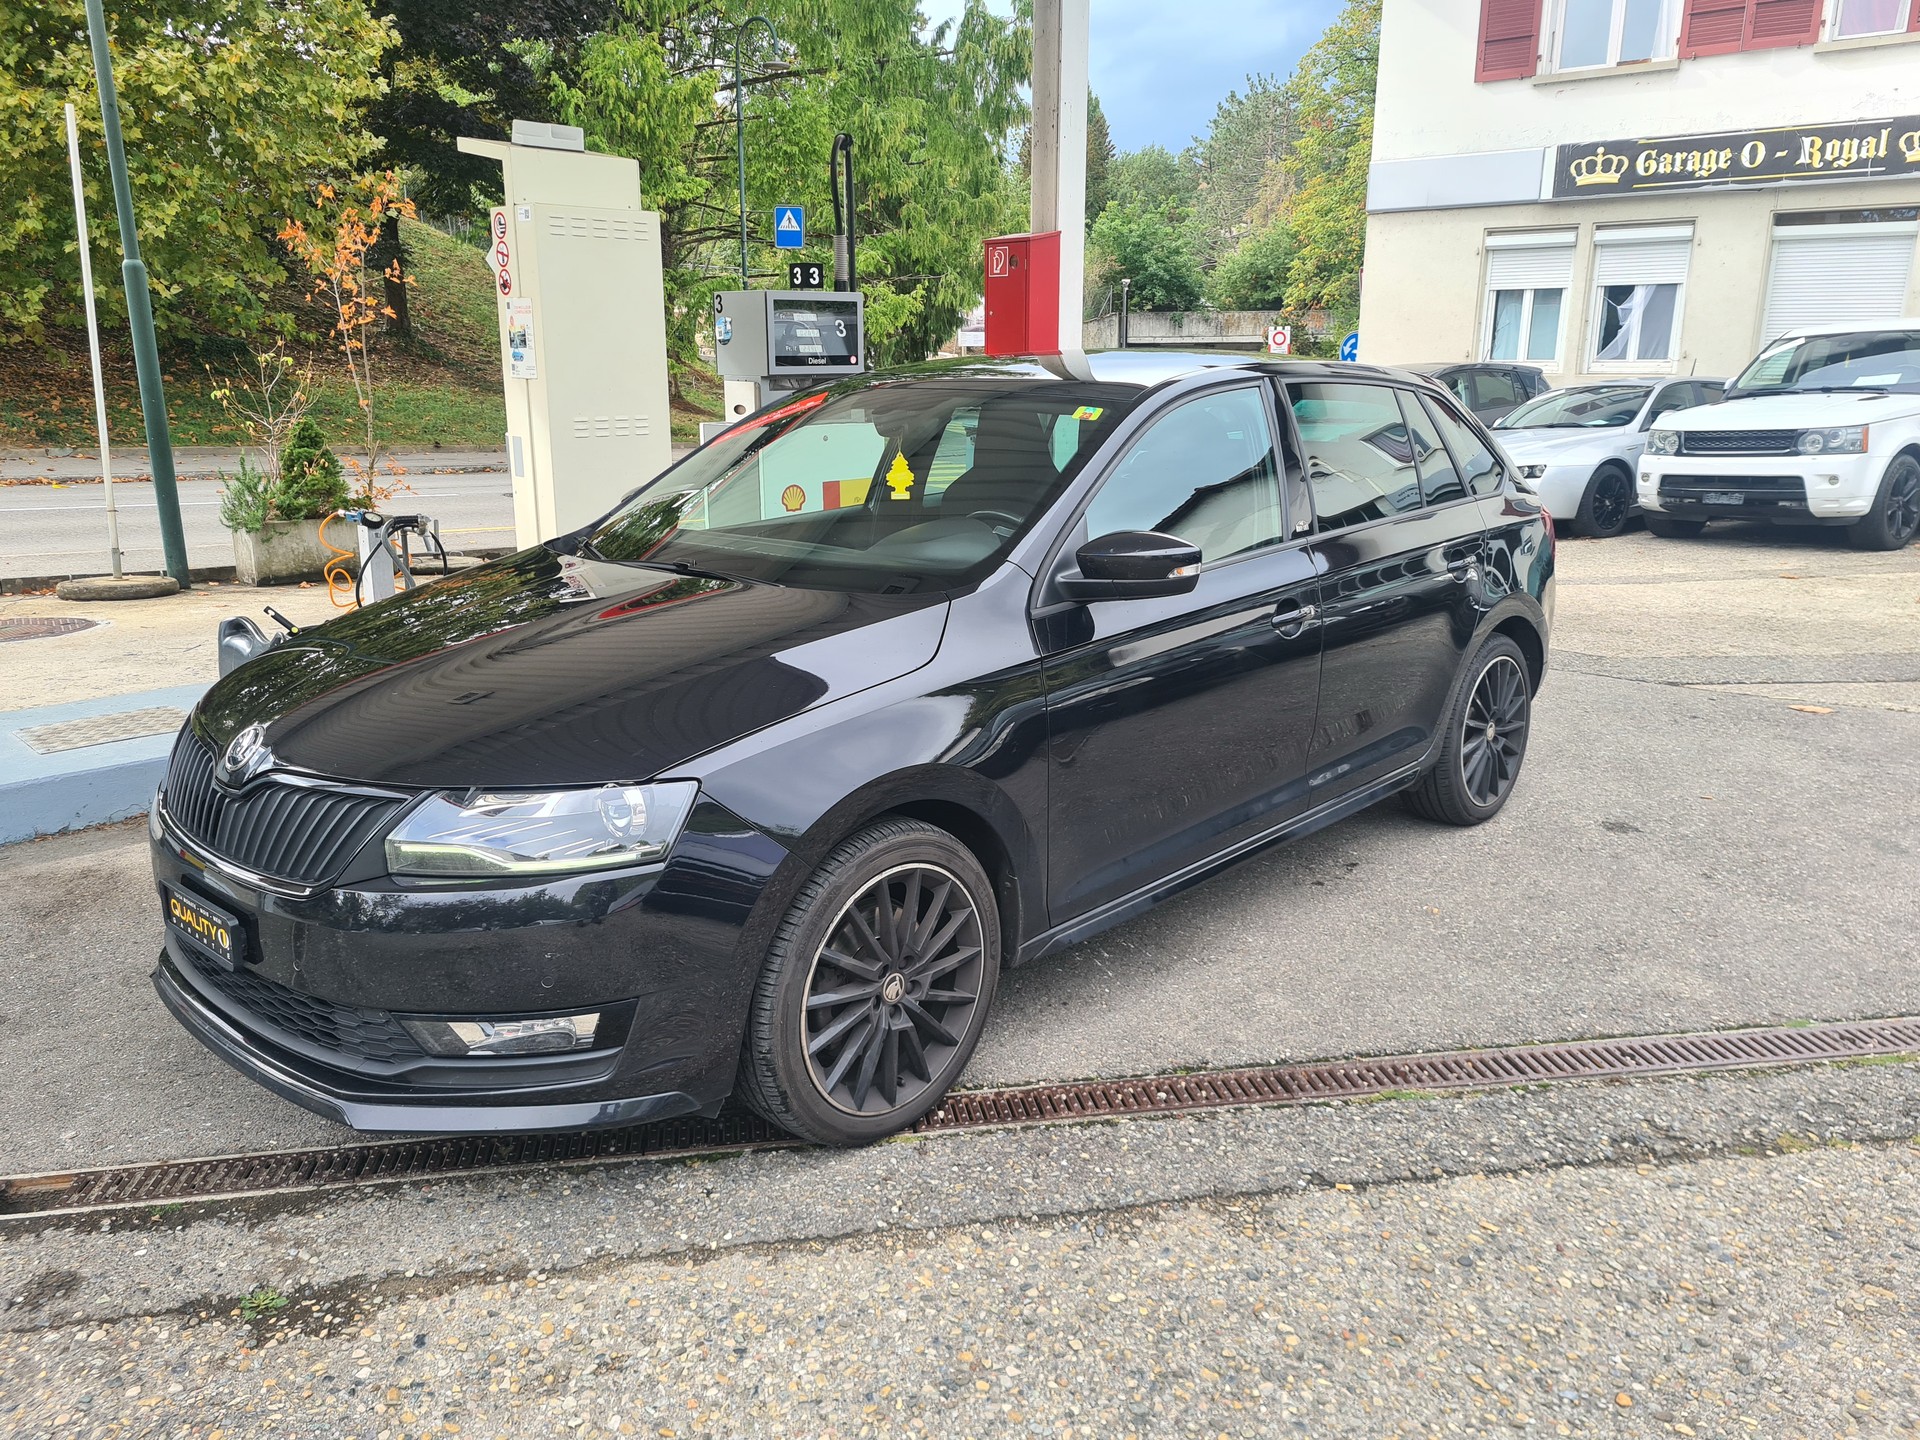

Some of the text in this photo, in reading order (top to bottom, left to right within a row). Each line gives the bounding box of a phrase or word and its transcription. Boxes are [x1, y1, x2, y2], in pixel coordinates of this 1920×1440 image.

[1636, 148, 1733, 178] Garage
[1739, 141, 1766, 169] O
[1796, 127, 1892, 169] Royal
[793, 267, 820, 285] 3 3
[715, 295, 723, 313] 3
[834, 319, 847, 338] 3
[808, 357, 827, 365] Diesel
[170, 898, 217, 941] QUALITY
